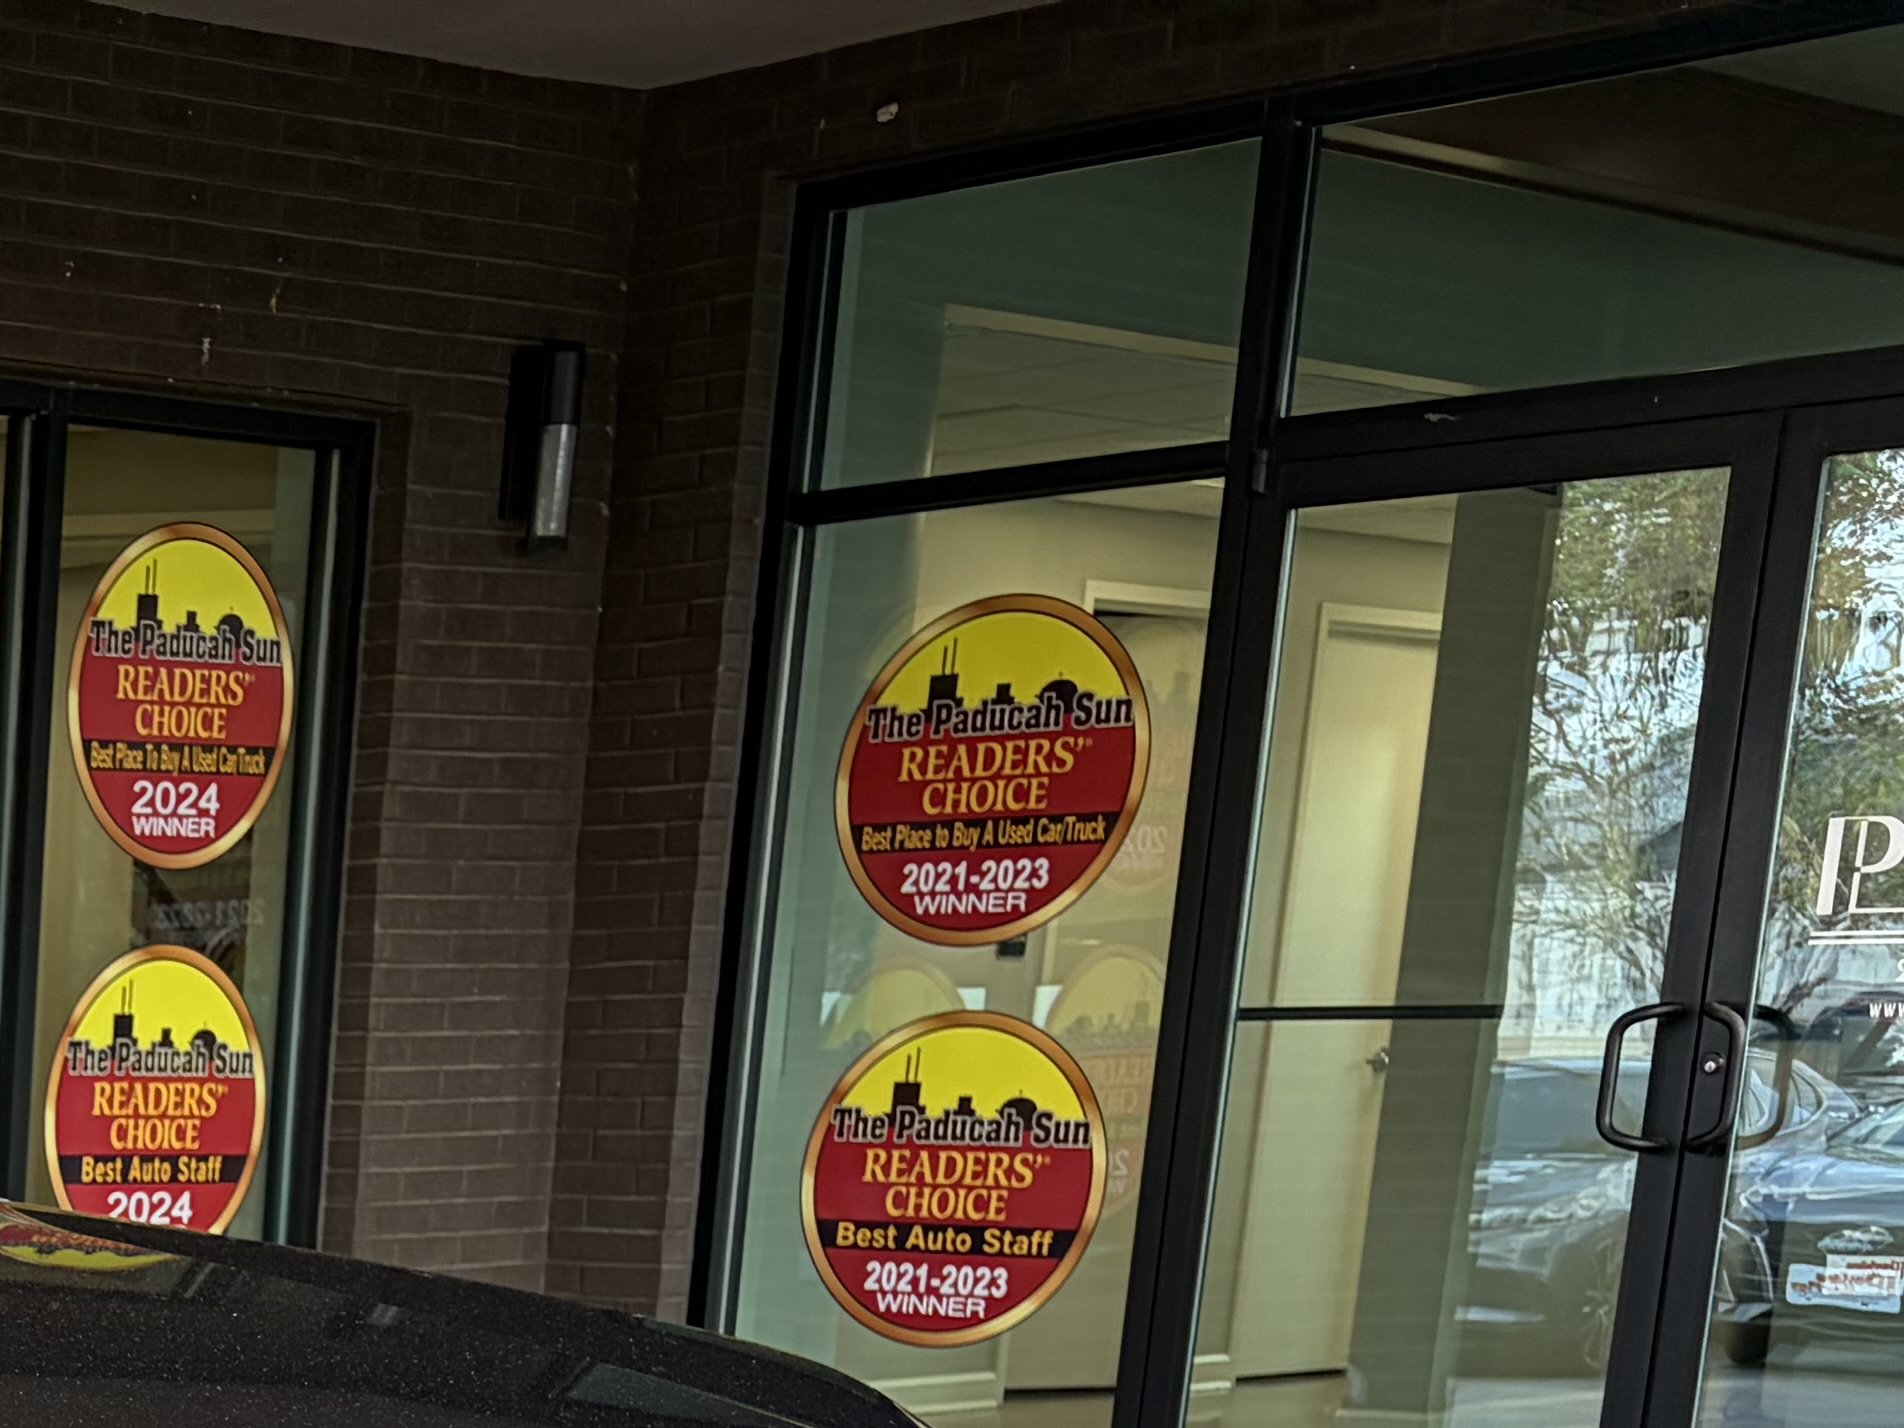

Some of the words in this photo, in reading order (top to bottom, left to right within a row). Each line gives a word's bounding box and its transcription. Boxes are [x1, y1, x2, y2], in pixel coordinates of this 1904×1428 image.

[90, 618, 134, 655] The
[139, 621, 234, 662] Paducah
[240, 630, 281, 665] Sun
[135, 704, 227, 738] CHOICE
[868, 706, 923, 742] The
[931, 693, 1063, 738] Paducah
[1072, 692, 1133, 728] Sun
[91, 742, 113, 769] Best
[116, 743, 143, 769] Place
[160, 745, 181, 776] Buy
[182, 746, 191, 771] A
[192, 746, 217, 772] Used
[131, 780, 220, 816] 2024
[922, 777, 1049, 815] CHOICE
[132, 816, 215, 838] WINNER
[862, 826, 892, 851] Best
[894, 824, 931, 850] Place
[935, 821, 949, 849] to
[952, 822, 980, 852] Buy
[982, 820, 993, 847] A
[998, 818, 1034, 845] Used
[1037, 815, 1106, 845] Car/Truck
[900, 858, 1050, 894] 2021-2023
[914, 892, 1027, 916] WINNER
[67, 1041, 109, 1074] The
[115, 1038, 208, 1076] Paducah
[214, 1043, 254, 1078] Sun
[110, 1118, 201, 1150] CHOICE
[833, 1108, 887, 1143] The
[894, 1106, 1022, 1146] Paducah
[1031, 1111, 1091, 1148] Sun
[81, 1156, 123, 1183] Best
[128, 1156, 171, 1183] Auto
[177, 1156, 223, 1183] Staff
[107, 1191, 193, 1225] 2024
[885, 1186, 1008, 1222] CHOICE
[836, 1222, 898, 1249] Best
[905, 1225, 972, 1253] Auto
[983, 1228, 1054, 1257] Staff
[863, 1260, 1008, 1299] 2021-2023
[876, 1292, 986, 1319] WINNER
